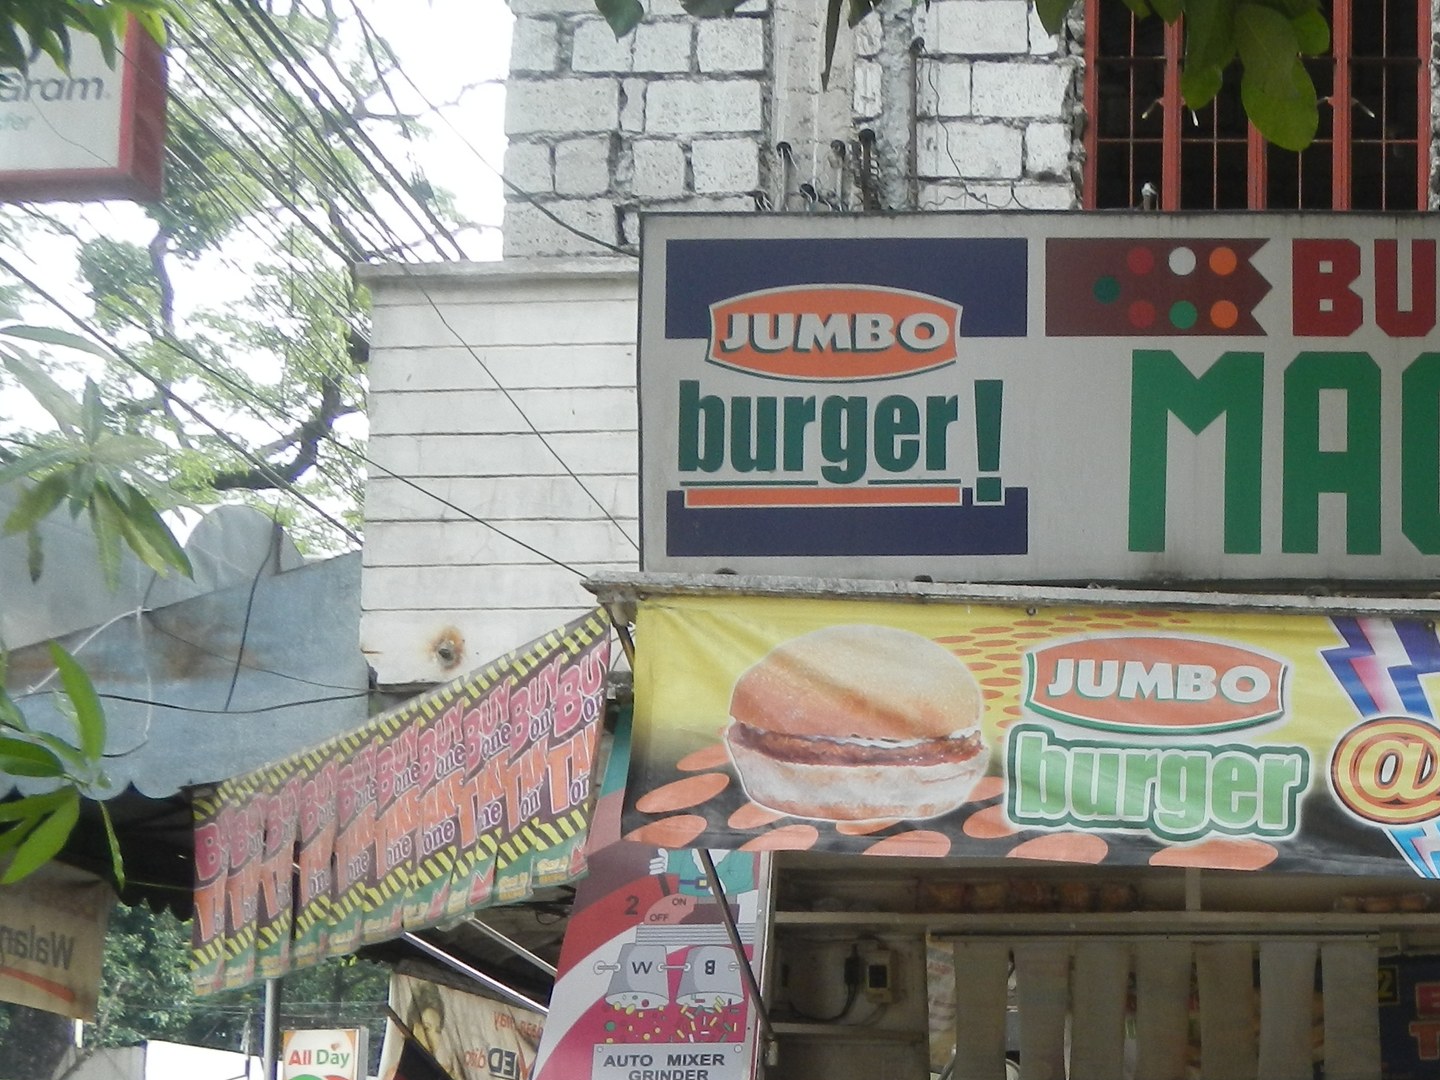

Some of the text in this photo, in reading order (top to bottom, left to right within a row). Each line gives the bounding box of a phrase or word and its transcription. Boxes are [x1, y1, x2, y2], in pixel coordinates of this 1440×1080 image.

[718, 312, 950, 353] JUMBO
[678, 379, 1004, 503] burger!
[1047, 658, 1271, 705] JUMBO
[1011, 727, 1305, 835] burger
[625, 896, 640, 915] 2
[672, 897, 687, 906] ON
[650, 913, 669, 922] OFF
[631, 961, 653, 974] W
[288, 1048, 350, 1069] All Day
[603, 1053, 725, 1067] AUTO MIXER
